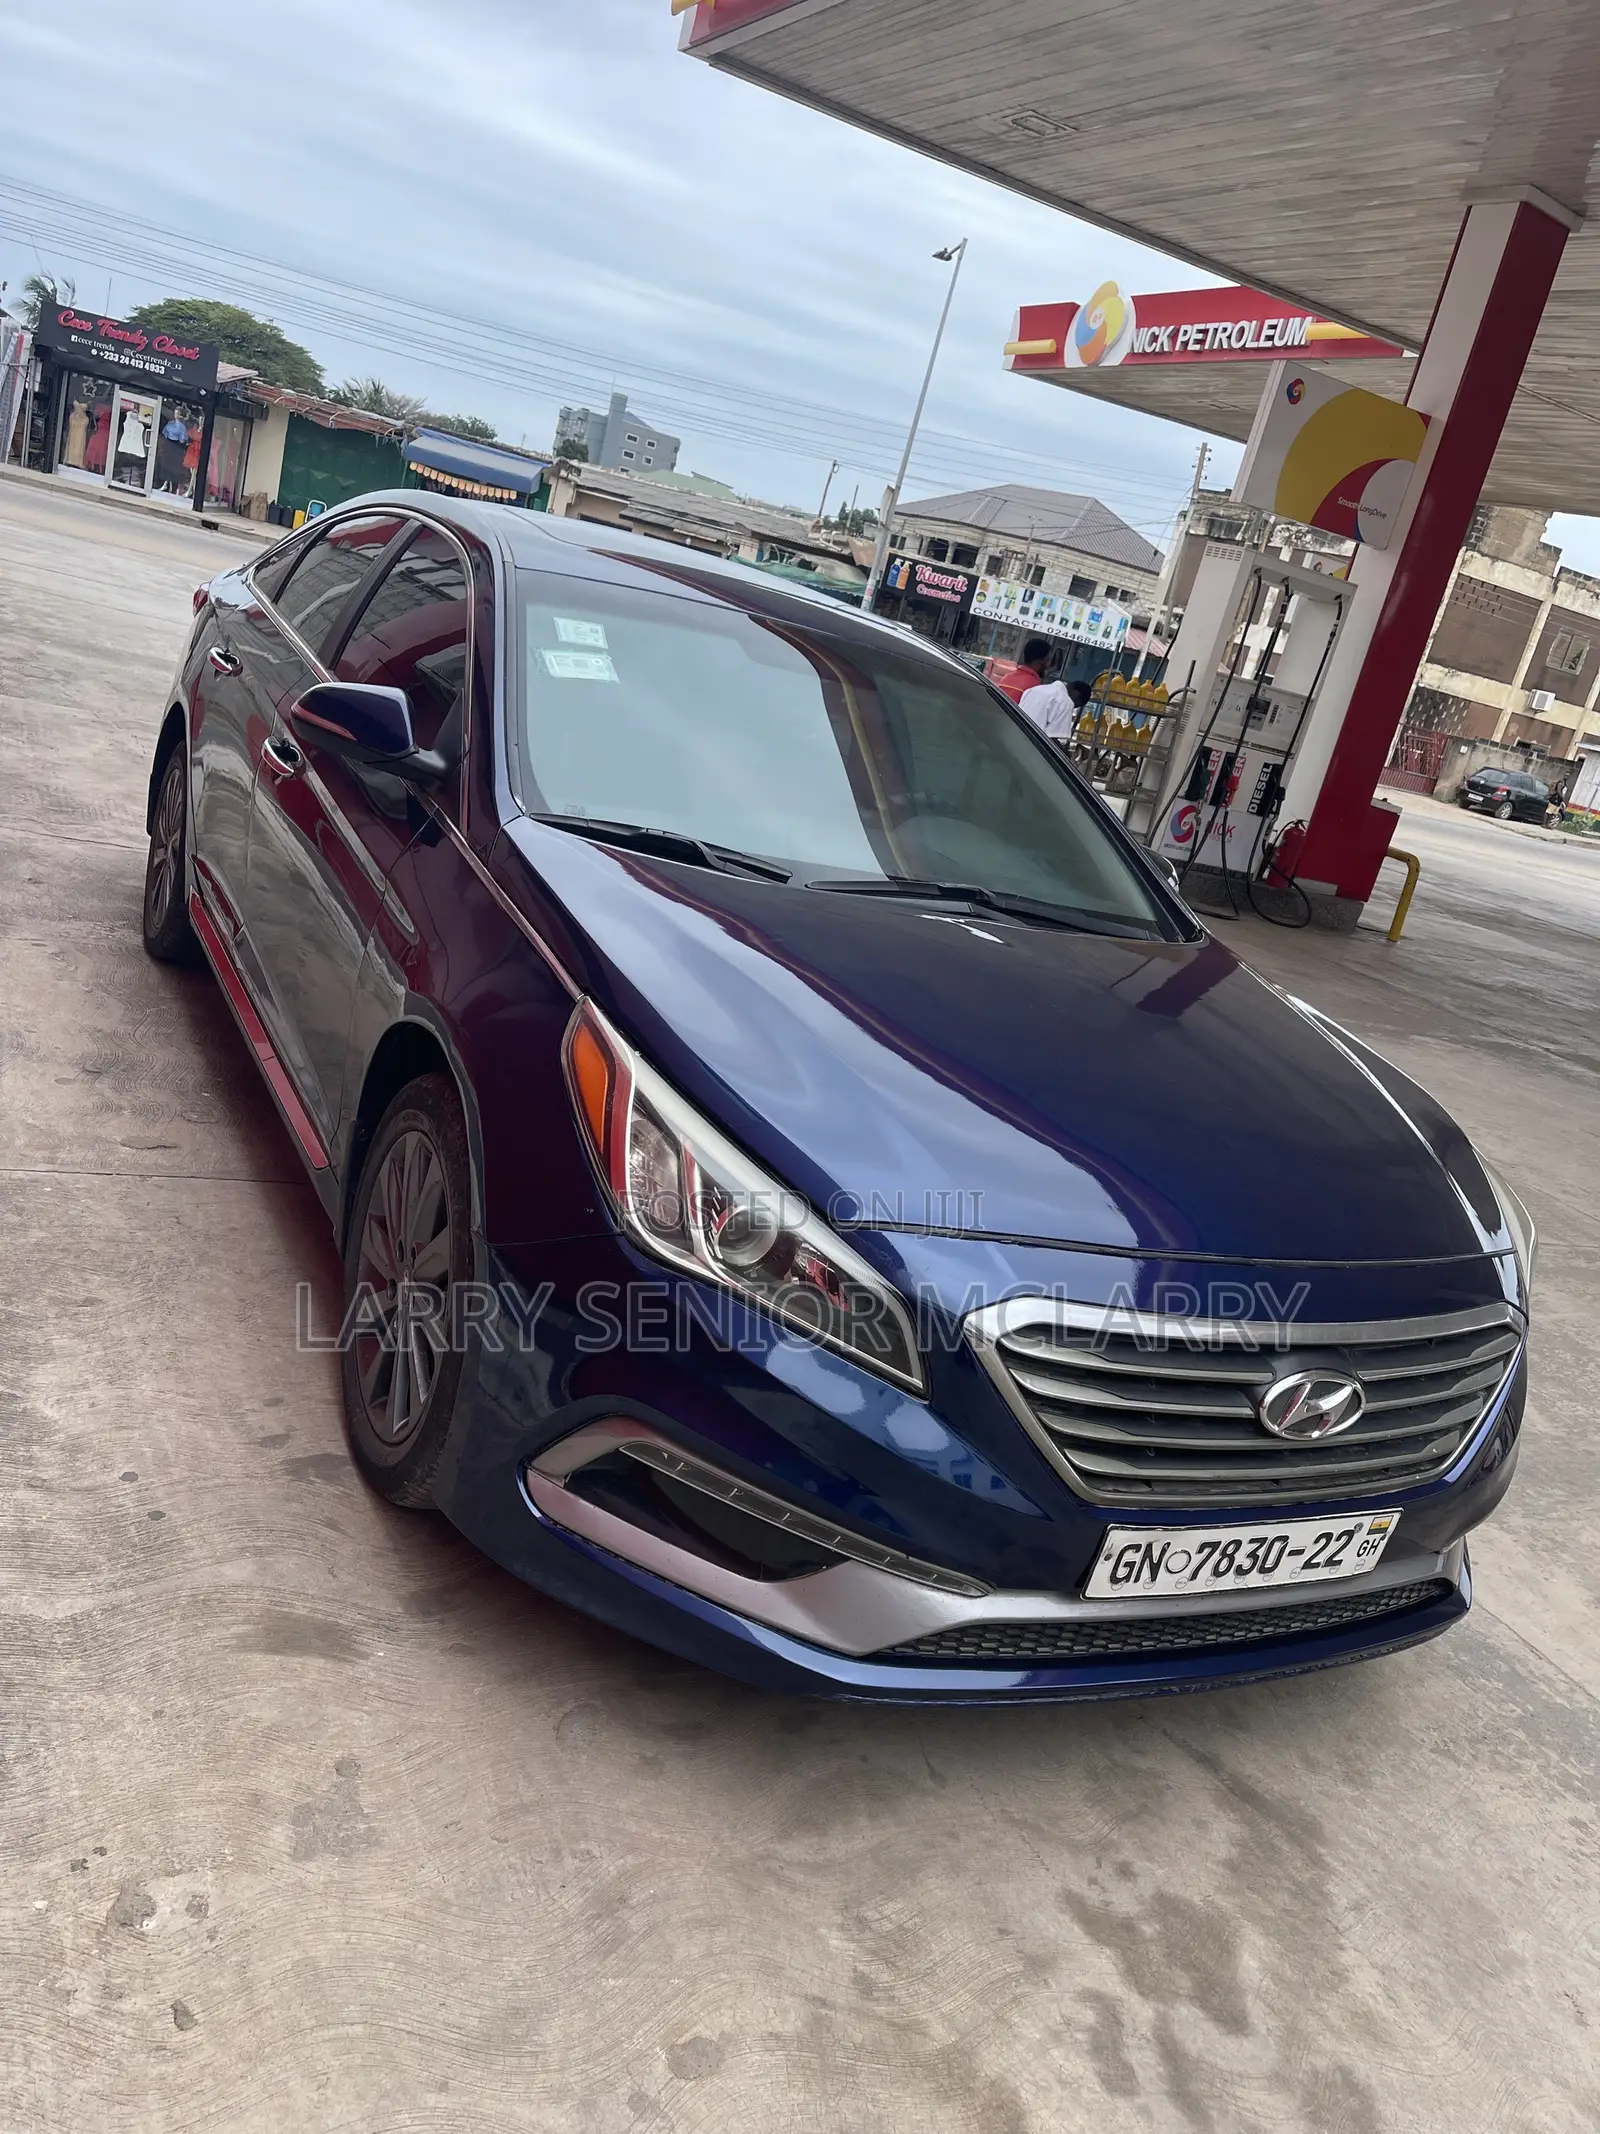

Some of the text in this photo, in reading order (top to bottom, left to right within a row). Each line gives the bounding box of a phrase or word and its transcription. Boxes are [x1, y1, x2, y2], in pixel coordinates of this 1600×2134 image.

[58, 310, 93, 332] Cece
[152, 335, 200, 360] Closet
[93, 341, 115, 352] trends
[1130, 316, 1312, 353] NICK PETROLEUM
[99, 351, 119, 363] +233
[119, 356, 130, 366] 24
[130, 358, 144, 370] 413
[916, 564, 968, 592] Kwarit
[973, 606, 1117, 650] CONTACT: 024468482
[1248, 763, 1273, 814] DIESEL
[1109, 1529, 1355, 1585] GN 7830-22
[1356, 1538, 1378, 1558] GH
